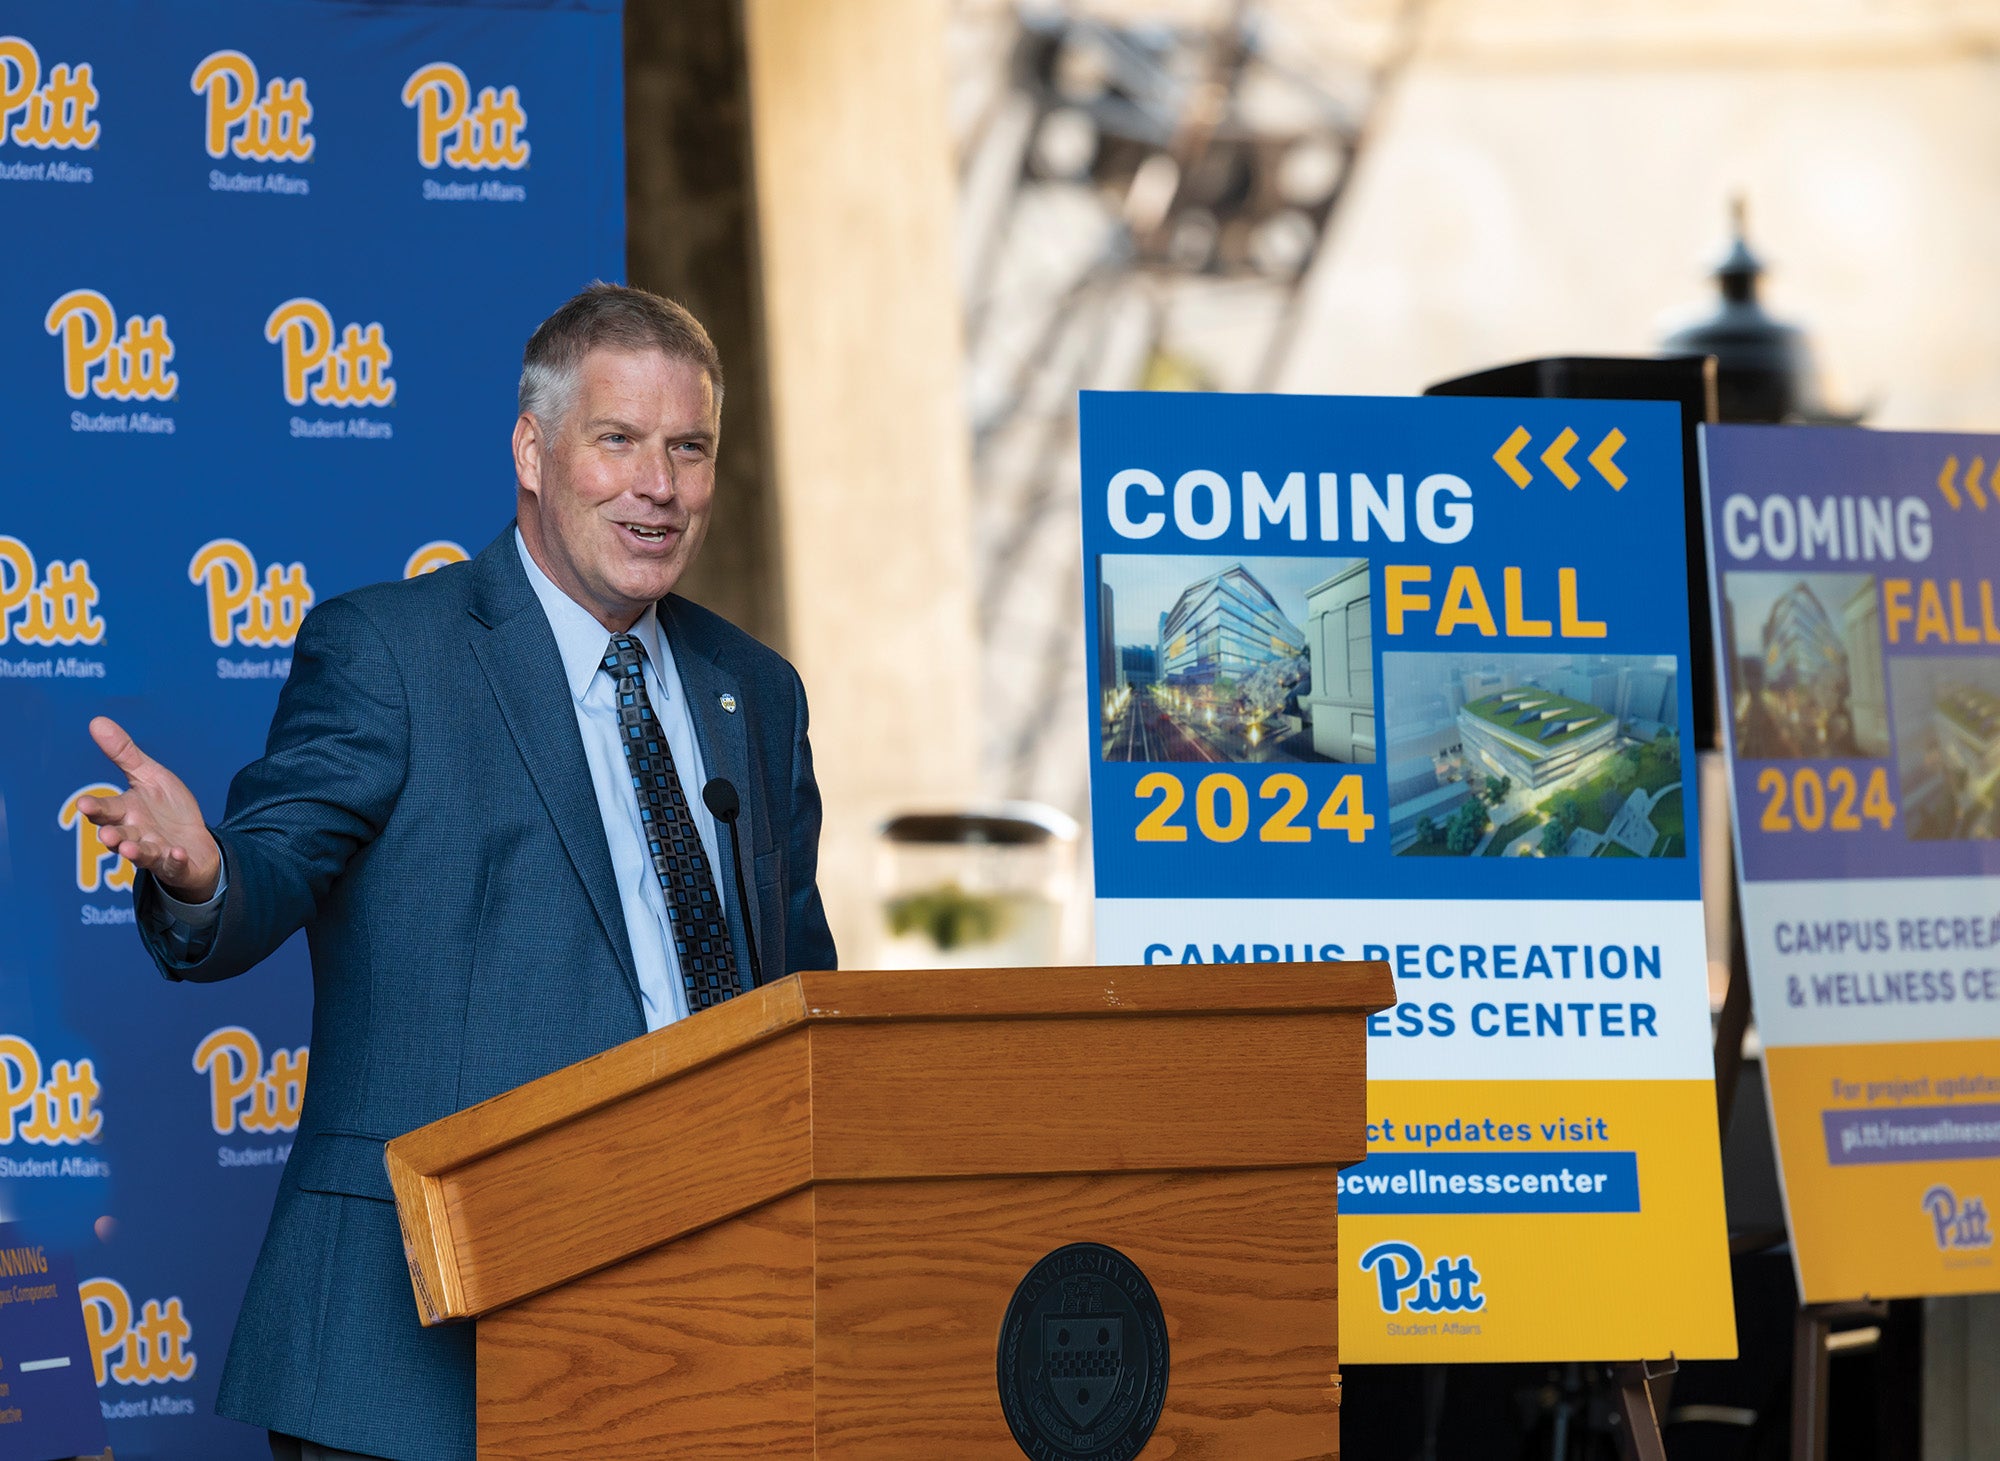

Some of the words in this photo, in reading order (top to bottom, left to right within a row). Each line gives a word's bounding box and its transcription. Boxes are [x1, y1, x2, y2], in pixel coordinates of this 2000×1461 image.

[191, 50, 315, 163] Pitt
[402, 62, 531, 172] Pitt
[46, 161, 93, 183] Affairs
[209, 169, 264, 192] Student
[264, 174, 310, 195] Affairs
[423, 179, 480, 201] Student
[479, 181, 526, 202] Affairs
[45, 289, 178, 402] Pitt
[265, 297, 396, 408] Pitt
[71, 410, 128, 432] Student
[128, 412, 176, 434] Affairs
[289, 416, 346, 438] Student
[346, 418, 393, 439] Affairs
[1107, 469, 1474, 543] COMING
[1723, 494, 1934, 562] COMING
[1384, 564, 1608, 638] FALL
[1884, 579, 2000, 645] FALL
[54, 657, 106, 678] Affairs
[216, 658, 271, 679] Student
[1134, 771, 1375, 843] 2024
[1757, 767, 1896, 831] 2024
[1775, 921, 1892, 955] CAMPUS
[1786, 973, 1806, 1007] &
[1811, 969, 1956, 1006] WELLNESS
[1470, 1002, 1658, 1038] CENTER
[1405, 1118, 1532, 1148] updates
[1540, 1117, 1609, 1142] visit
[60, 1157, 110, 1178] Affairs
[218, 1146, 273, 1168] Student
[1337, 1168, 1608, 1195] ecwellnesscenter
[1922, 1184, 1995, 1251] Pitt
[0, 1246, 48, 1277] NNING
[1023, 1253, 1125, 1302] UNIVERSITY
[1125, 1274, 1149, 1301] OF
[1359, 1240, 1486, 1314] Pitt
[78, 1277, 197, 1388] Pitt
[1386, 1322, 1437, 1337] Student
[1441, 1322, 1482, 1336] Affairs
[100, 1399, 149, 1419] tudent
[150, 1396, 195, 1415] Affairs
